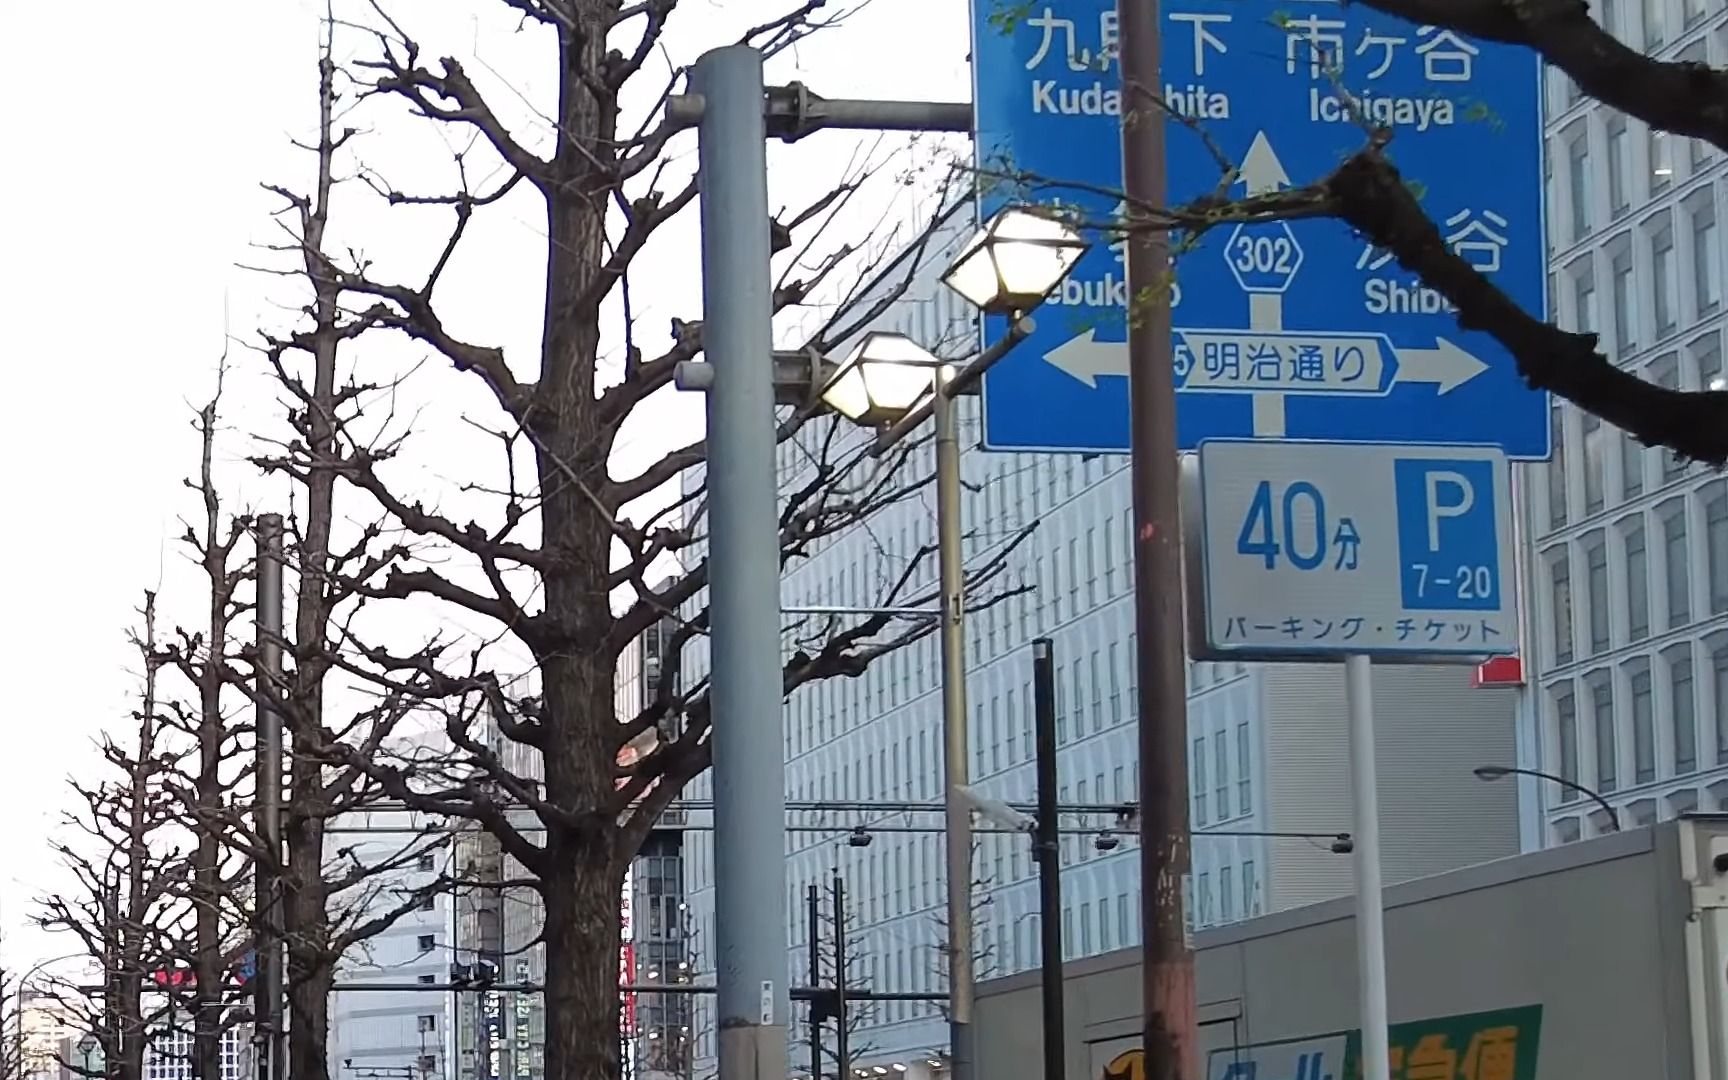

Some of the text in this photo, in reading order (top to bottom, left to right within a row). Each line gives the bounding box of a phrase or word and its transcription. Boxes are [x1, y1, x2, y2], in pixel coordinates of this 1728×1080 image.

[1031, 79, 1231, 119] Kudahita
[1236, 235, 1292, 275] 302
[1364, 278, 1462, 315] Shib
[1203, 341, 1366, 382] 明治通り
[1236, 479, 1361, 572] 40分
[1424, 470, 1476, 552] P
